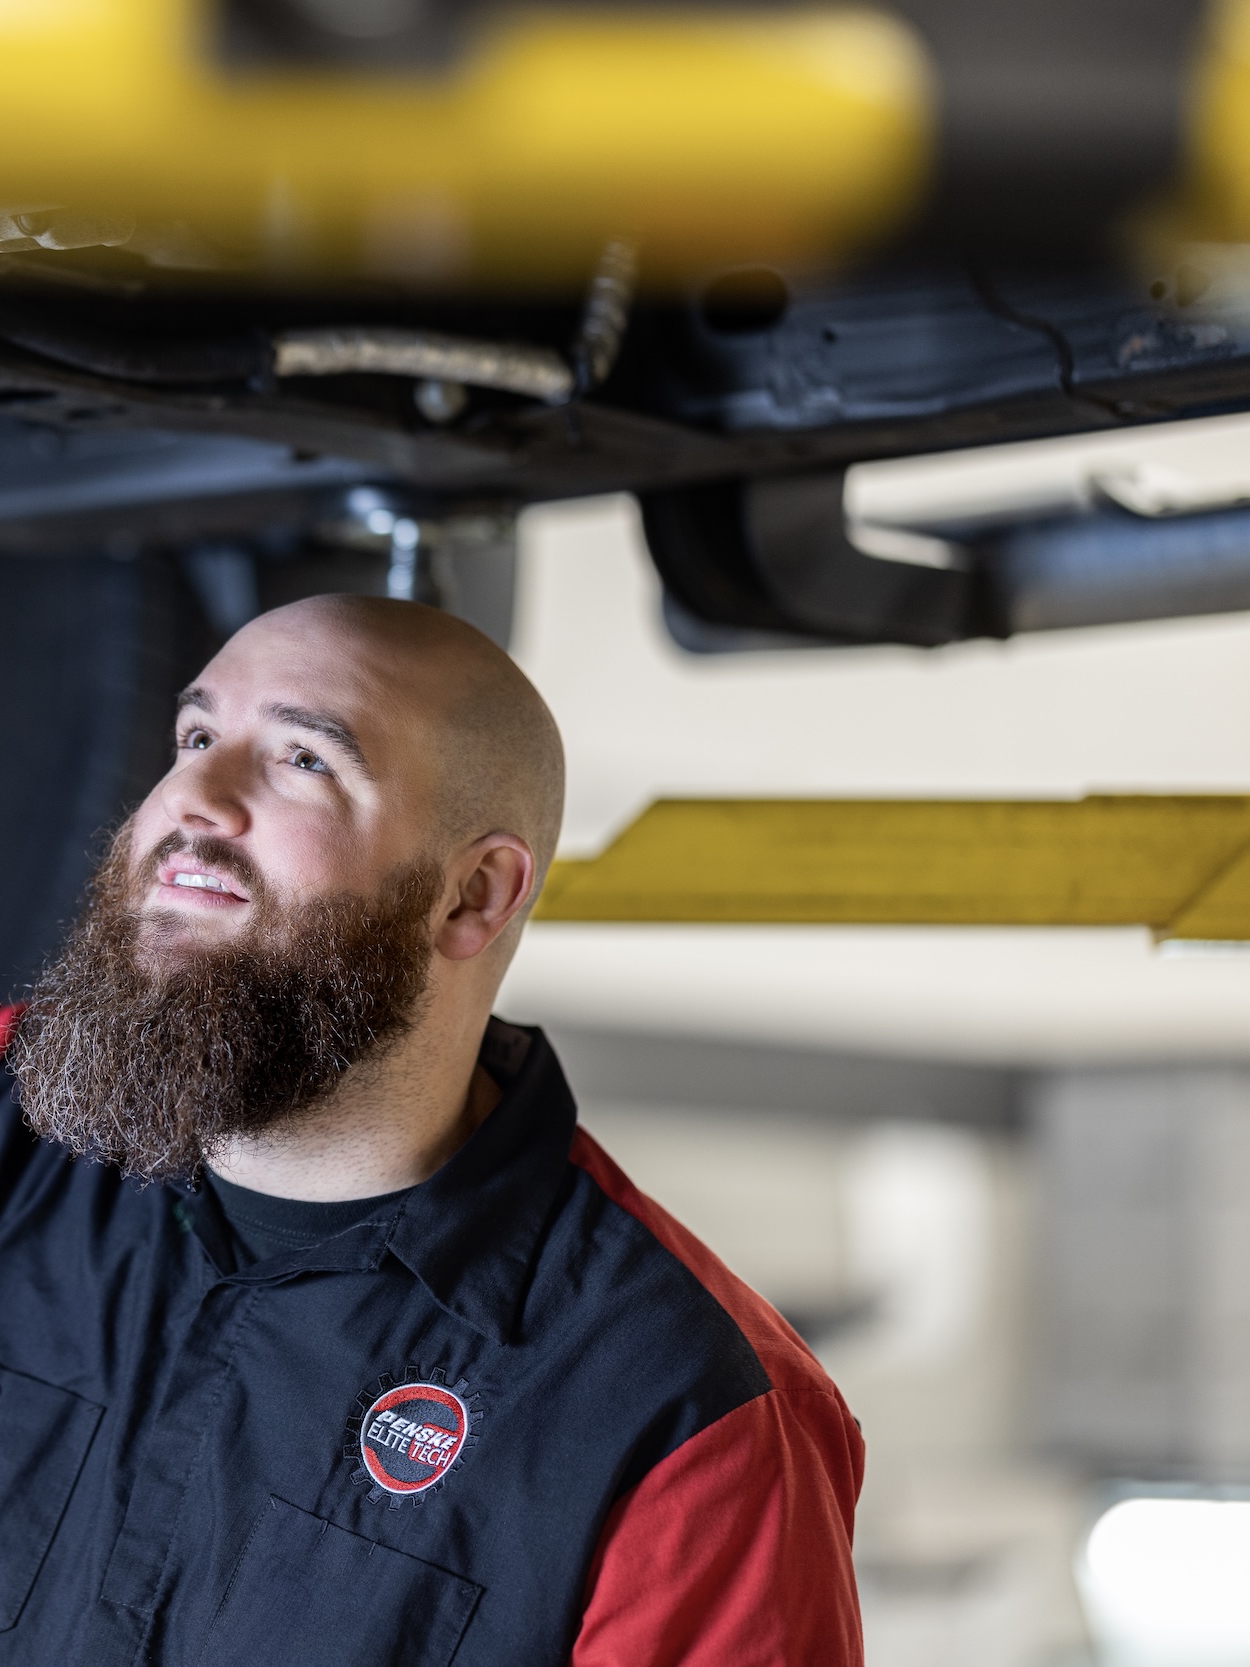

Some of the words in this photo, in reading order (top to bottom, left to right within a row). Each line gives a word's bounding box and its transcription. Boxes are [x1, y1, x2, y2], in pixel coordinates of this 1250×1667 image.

[367, 1421, 411, 1454] ELITE
[411, 1441, 451, 1467] TECH
[376, 1410, 458, 1450] PENSKE
